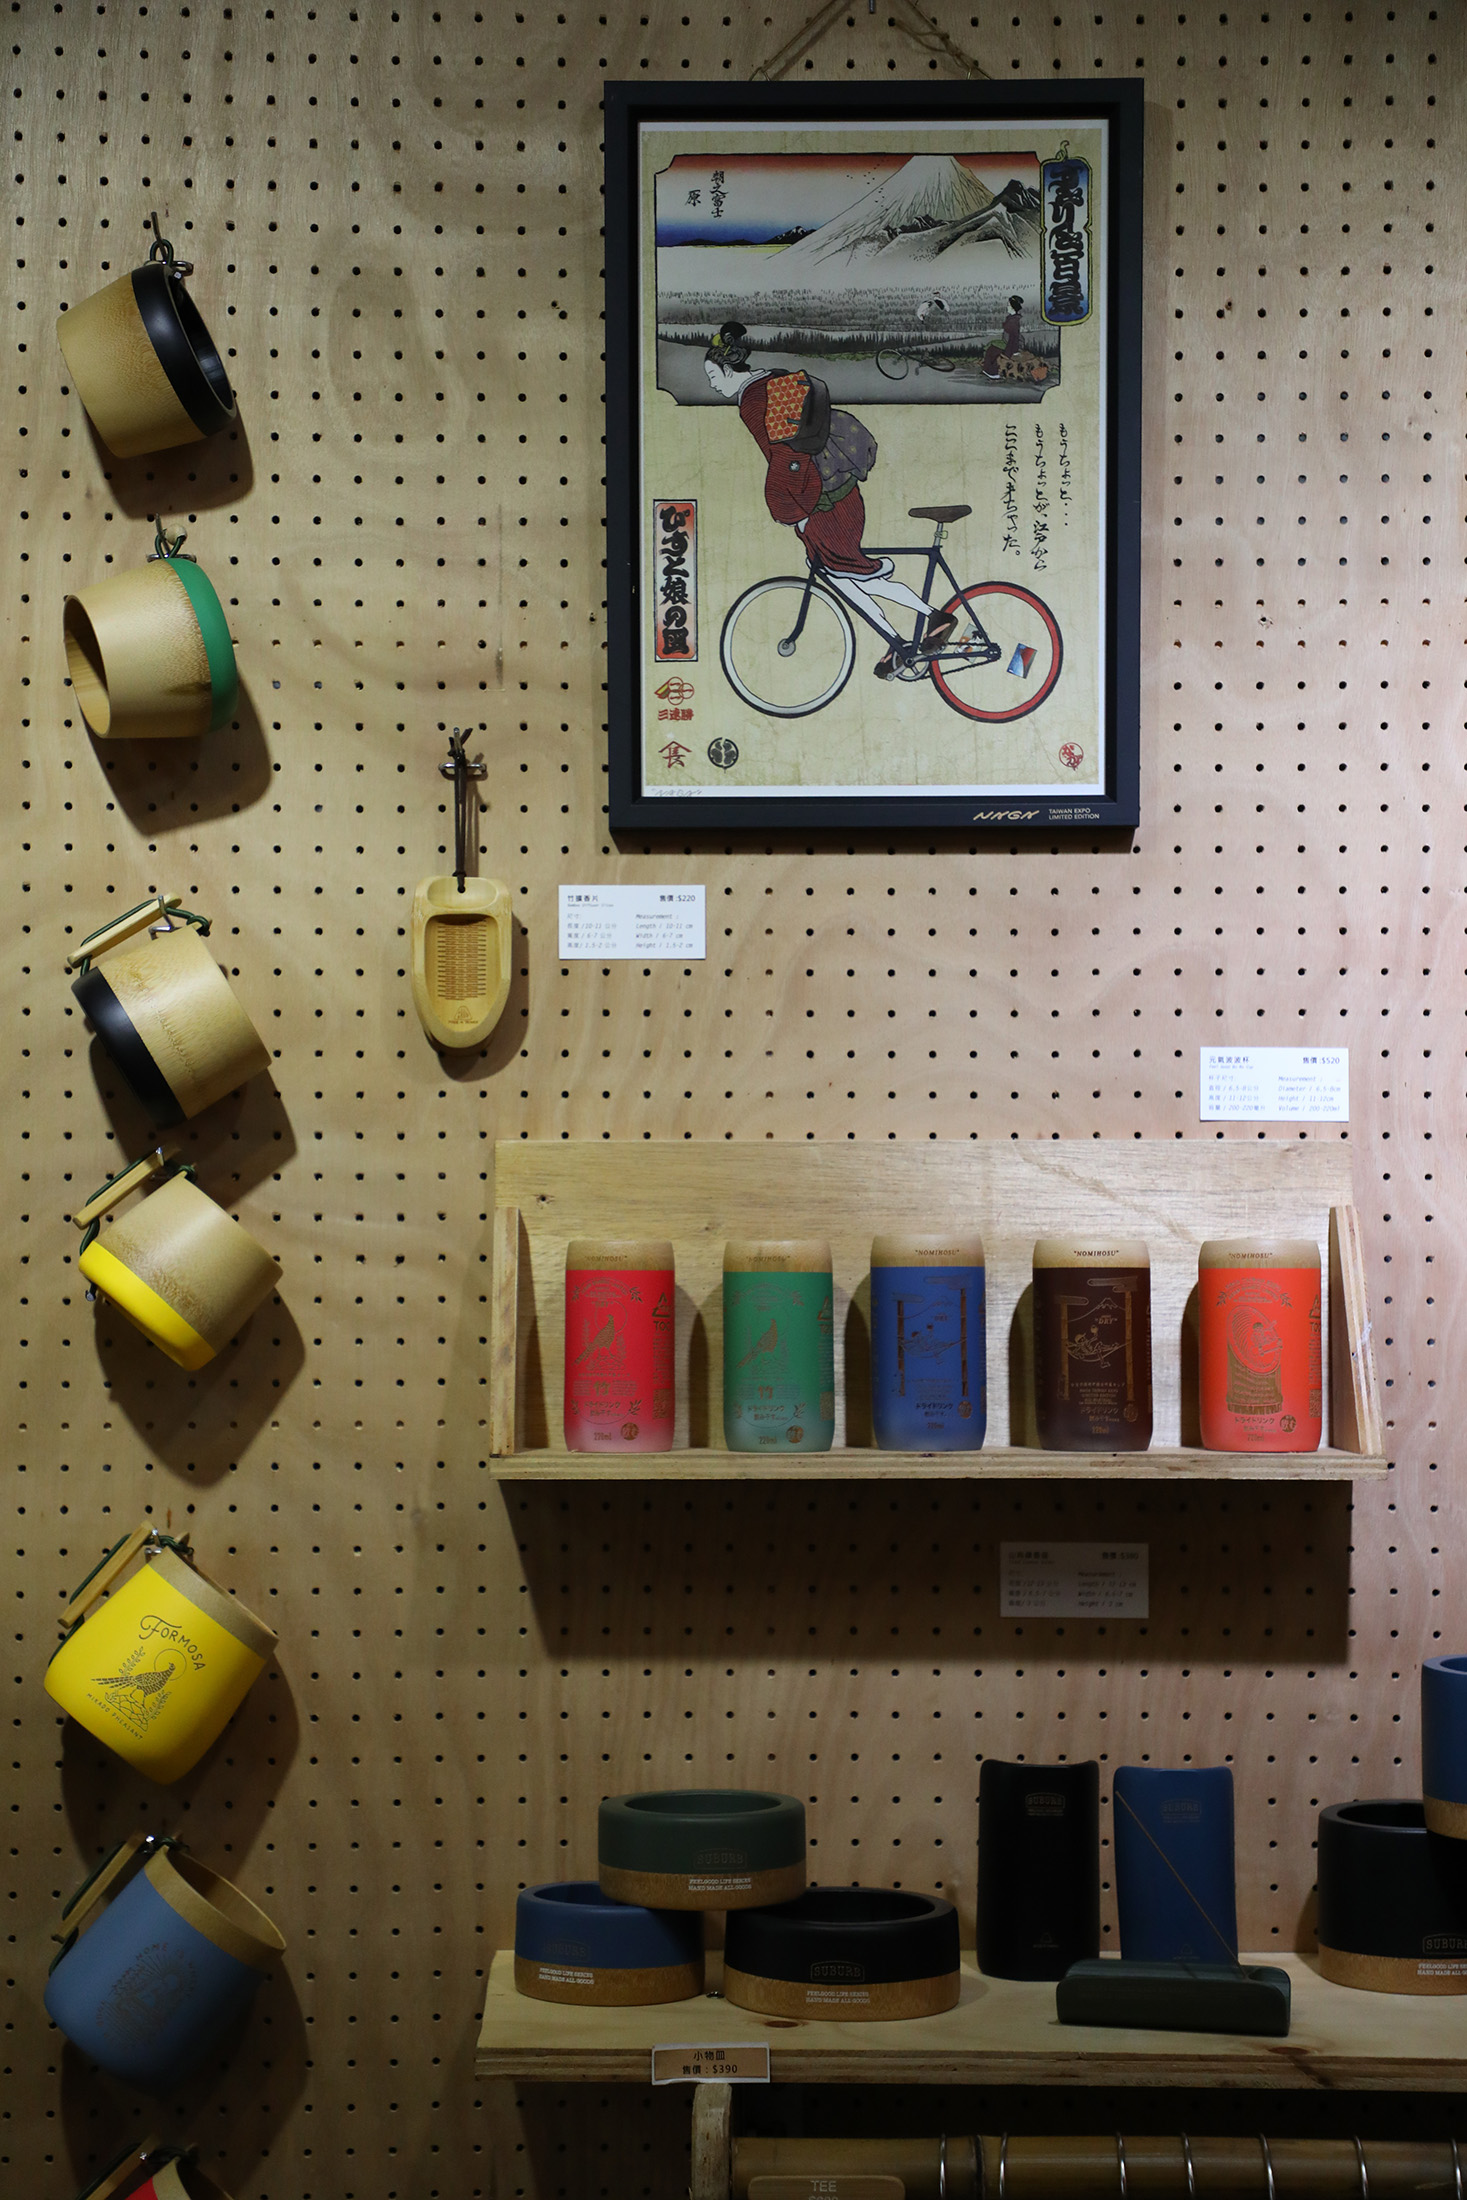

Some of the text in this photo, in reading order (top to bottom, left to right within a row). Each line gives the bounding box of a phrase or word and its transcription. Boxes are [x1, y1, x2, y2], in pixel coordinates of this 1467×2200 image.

[915, 1249, 960, 1257] "NOMIHOSU"
[1073, 1249, 1119, 1258] "NOMIHOSU"
[87, 1692, 111, 1713] MIKADO
[697, 1853, 744, 1865] SUBURB
[814, 1965, 861, 1977] SUBURB
[694, 2051, 726, 2061] 小物皿
[810, 2180, 837, 2192] TEE
